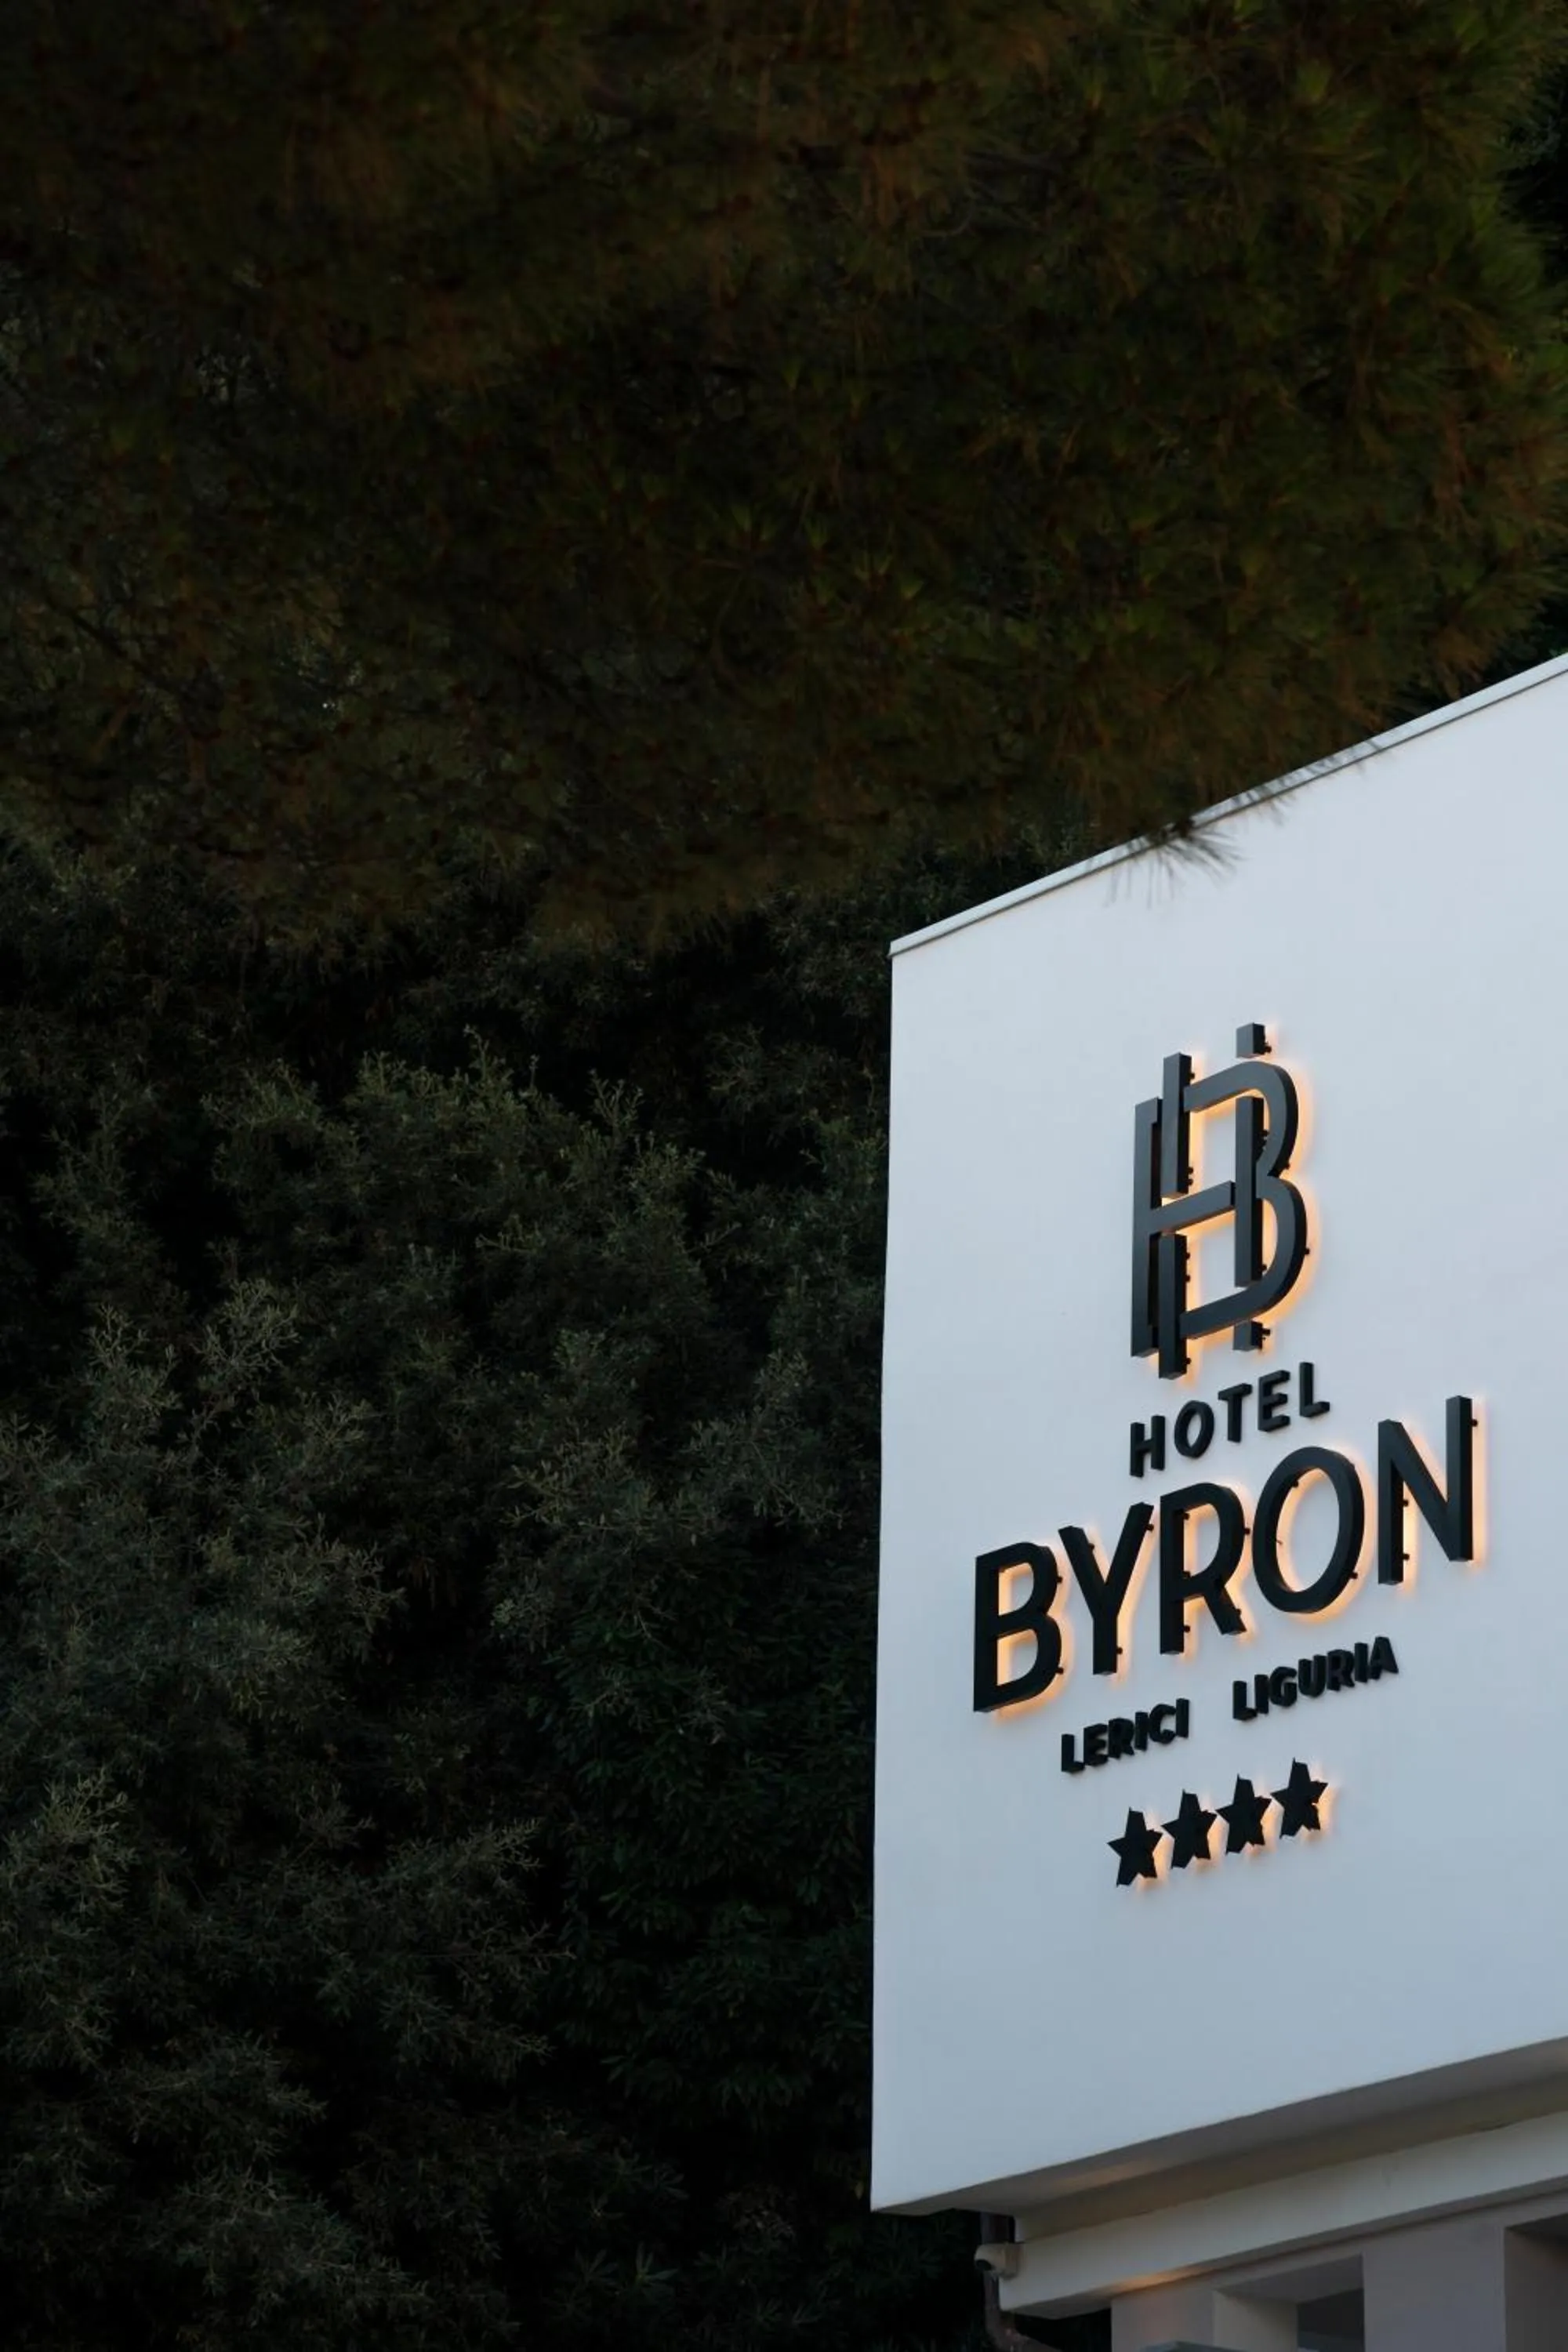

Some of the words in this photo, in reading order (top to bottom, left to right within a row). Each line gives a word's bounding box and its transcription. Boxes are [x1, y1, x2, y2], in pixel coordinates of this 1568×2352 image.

[1130, 1362, 1330, 1479] HOTEL
[973, 1395, 1478, 1713] BYRON
[1061, 1697, 1190, 1775] LERICI
[1232, 1636, 1399, 1722] LIGURIA
